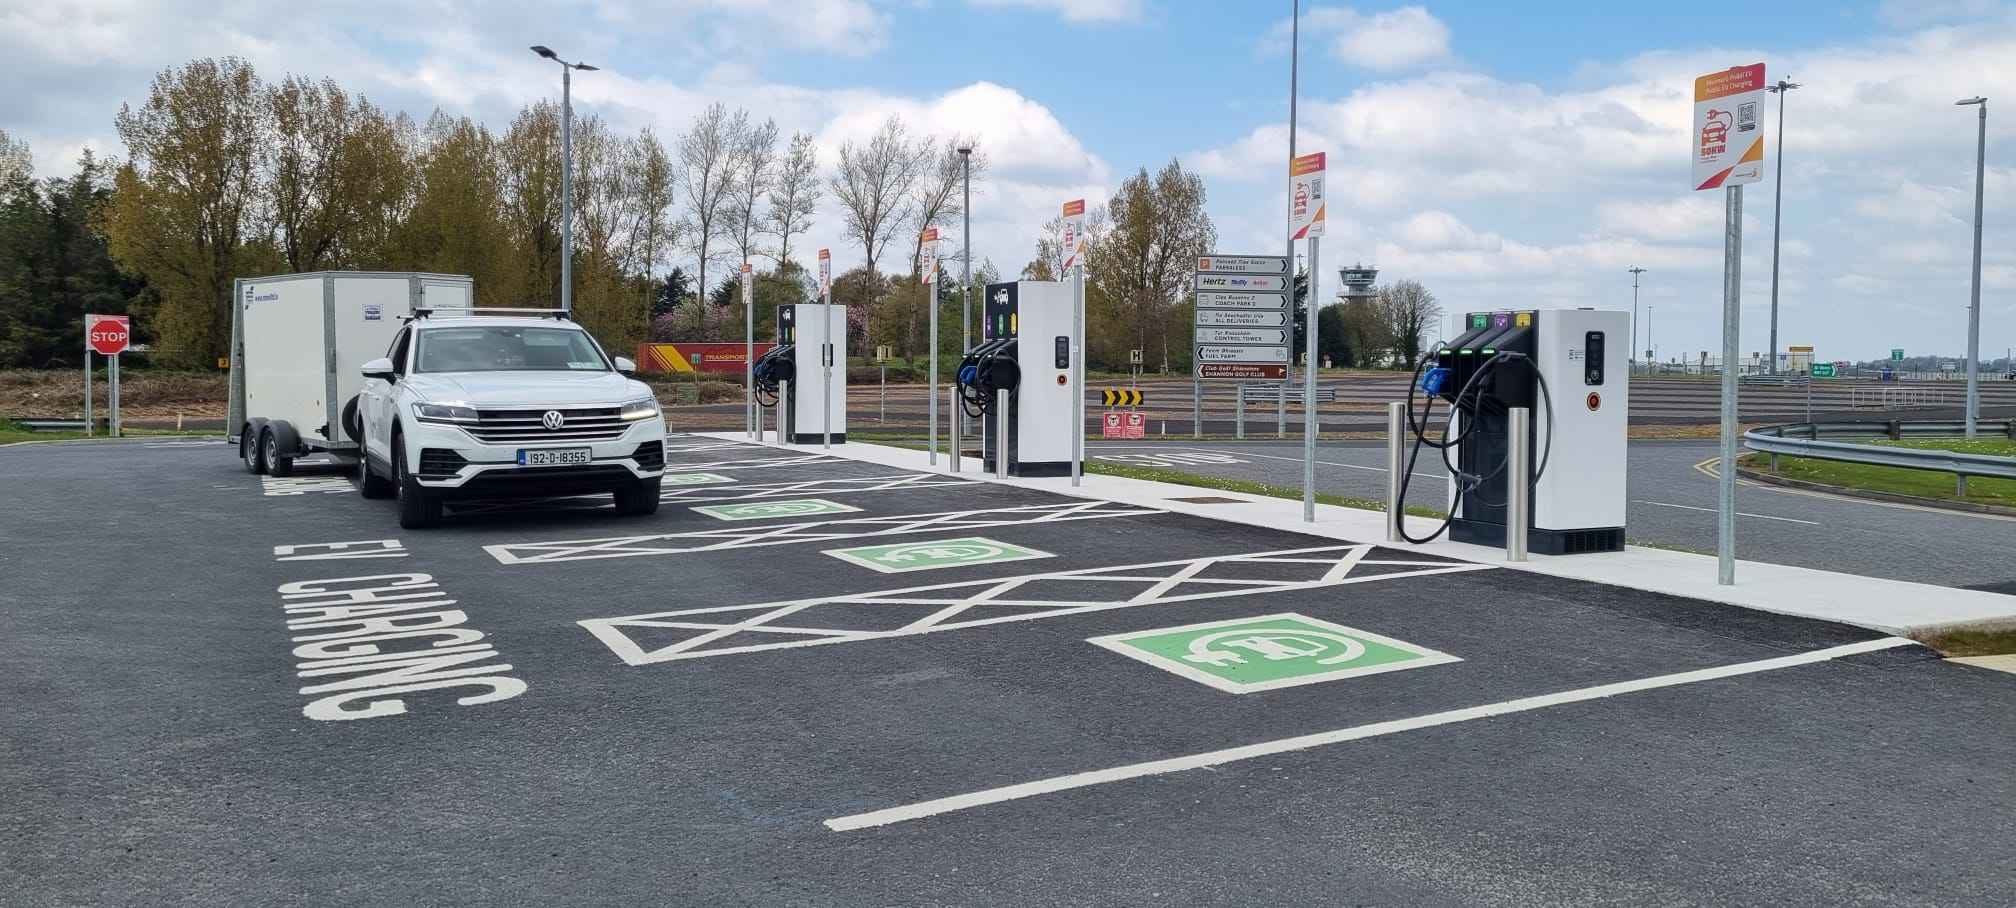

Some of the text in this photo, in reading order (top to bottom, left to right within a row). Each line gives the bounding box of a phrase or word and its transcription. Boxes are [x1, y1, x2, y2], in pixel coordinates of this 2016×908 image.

[1203, 277, 1226, 285] Hertz
[92, 332, 127, 342] STOP
[530, 452, 586, 464] 192-D-18355
[277, 572, 528, 721] CHARGING
